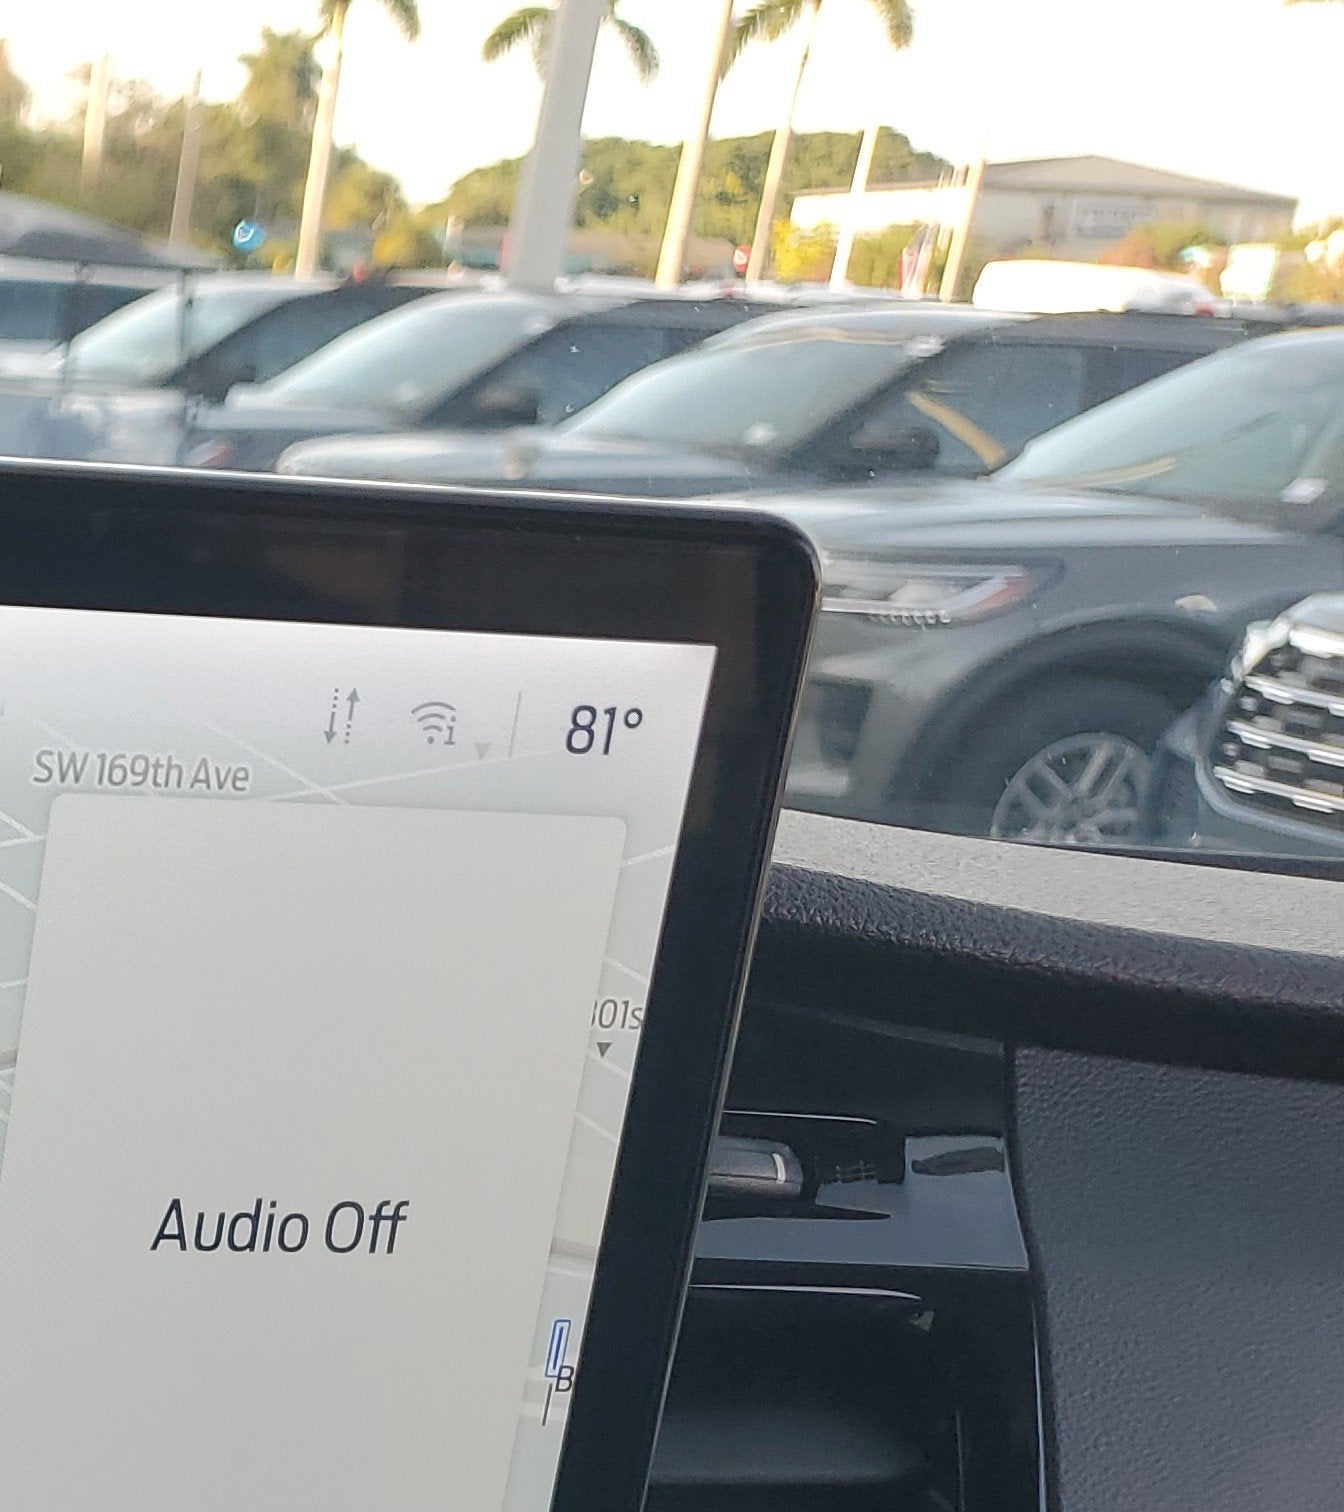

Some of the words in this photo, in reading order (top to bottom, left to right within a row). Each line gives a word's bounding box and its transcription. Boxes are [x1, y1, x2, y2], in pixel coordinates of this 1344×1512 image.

[566, 705, 643, 755] 81°
[33, 750, 90, 785] SW
[97, 753, 182, 790] 169th
[190, 759, 251, 793] Ave
[151, 1198, 310, 1255] Audio
[324, 1200, 408, 1255] Off
